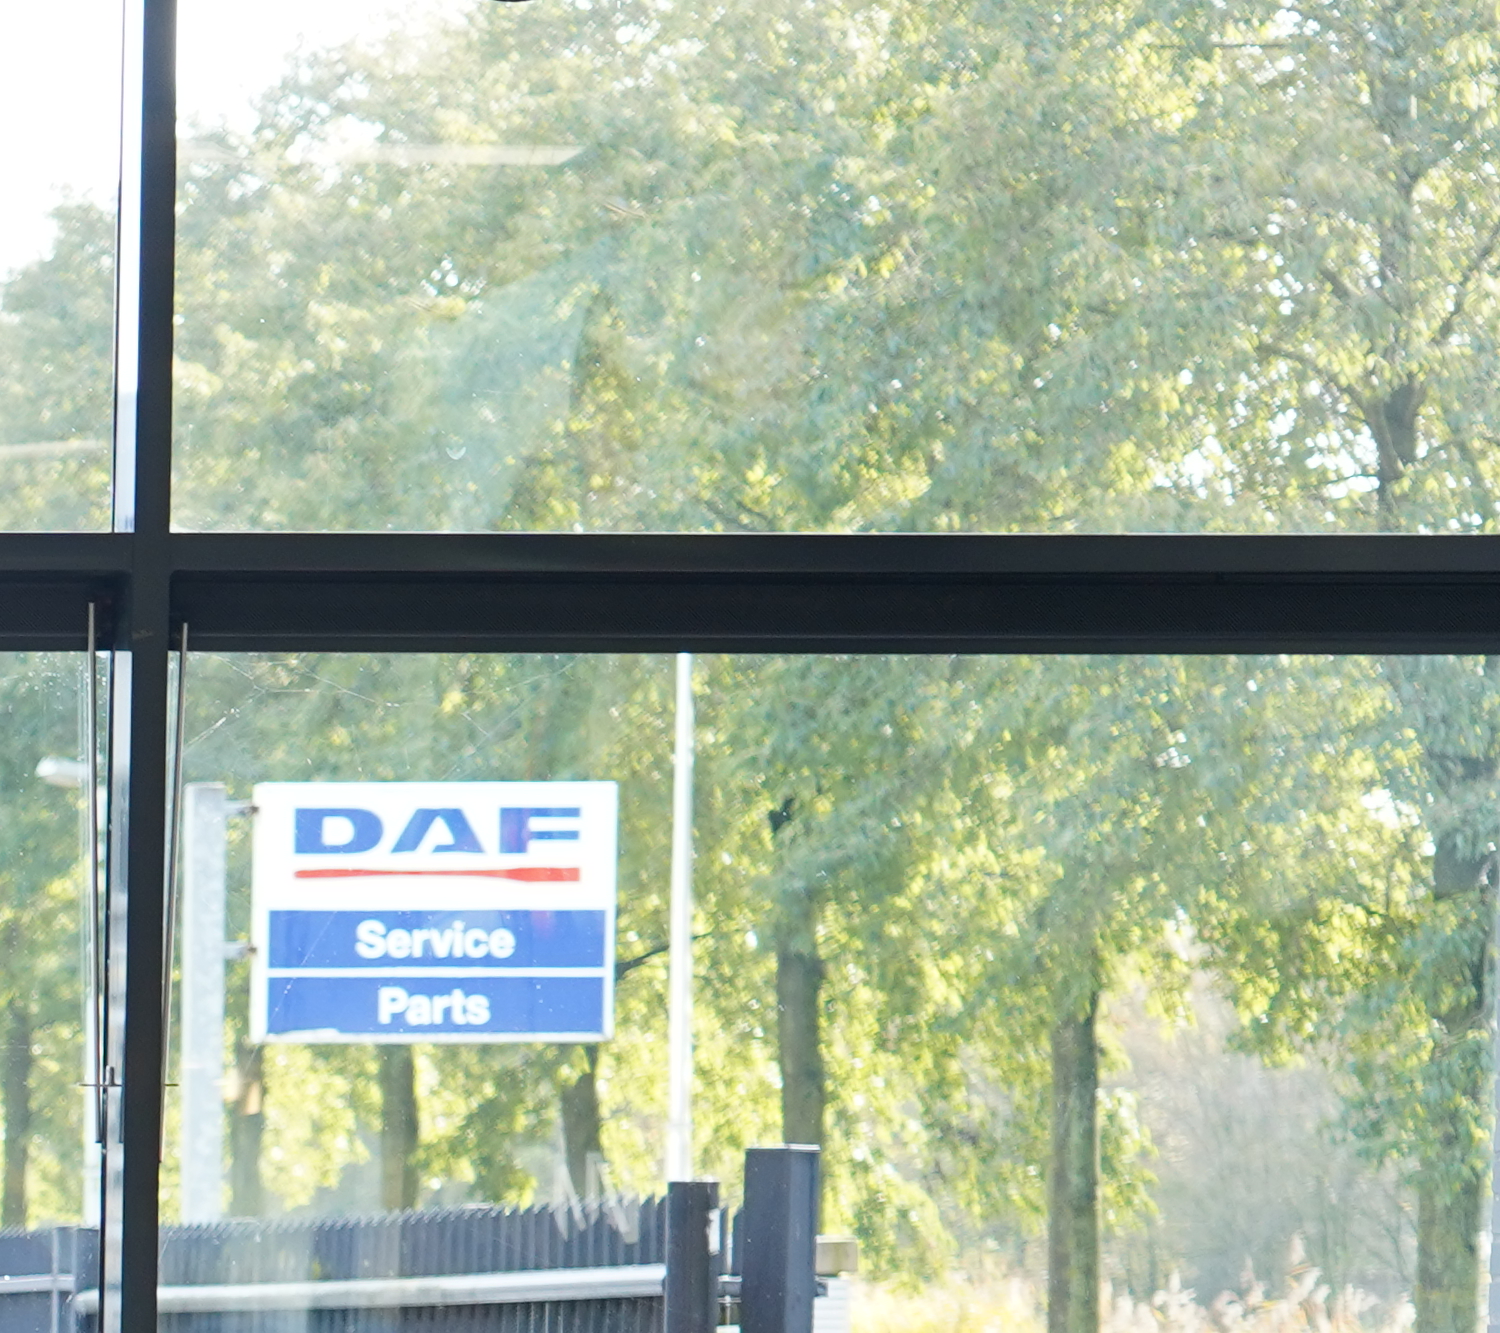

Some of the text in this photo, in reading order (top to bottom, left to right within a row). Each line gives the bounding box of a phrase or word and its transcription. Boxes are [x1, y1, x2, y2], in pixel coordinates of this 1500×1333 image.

[294, 807, 580, 854] DAF
[356, 920, 516, 959] Service
[378, 987, 490, 1025] Parts
